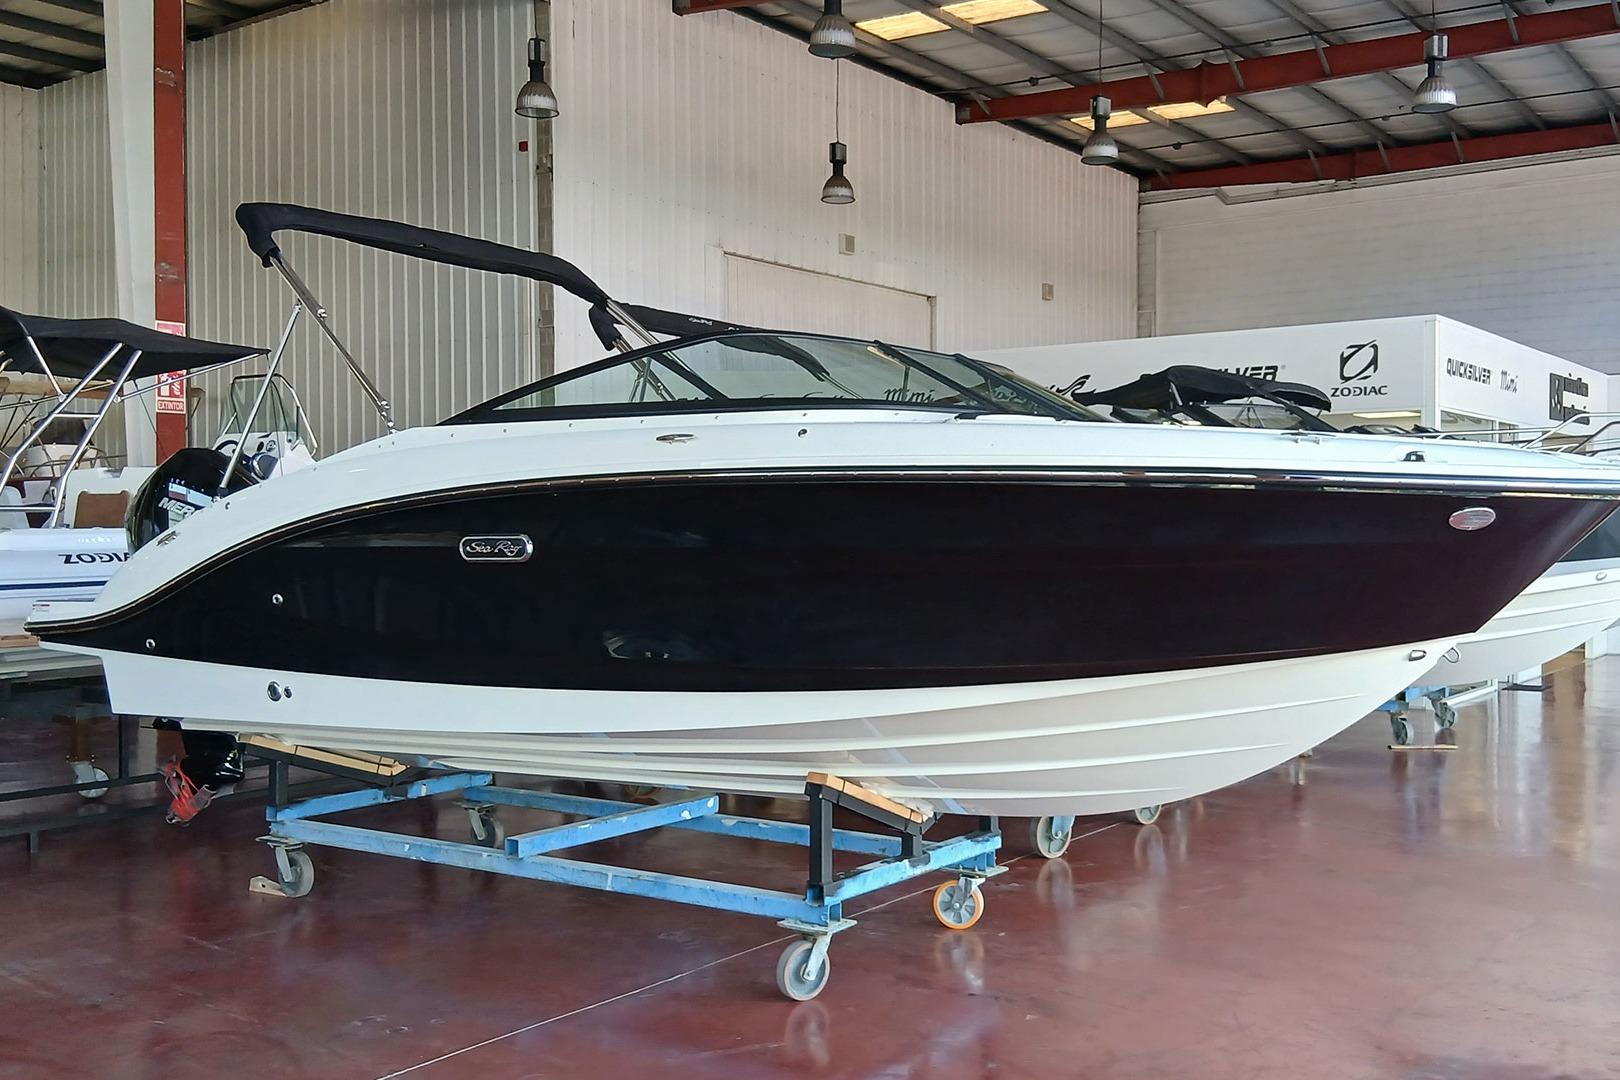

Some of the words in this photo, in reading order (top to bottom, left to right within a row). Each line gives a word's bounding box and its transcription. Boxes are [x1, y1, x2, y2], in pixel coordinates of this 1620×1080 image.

[1446, 357, 1491, 385] QUICKSILVER
[1330, 385, 1388, 398] ZODIAC
[158, 401, 184, 411] EXTINTOR
[158, 497, 196, 518] MER
[466, 541, 494, 553] Sea
[494, 540, 523, 557] Ray
[58, 552, 131, 564] ZODIA
